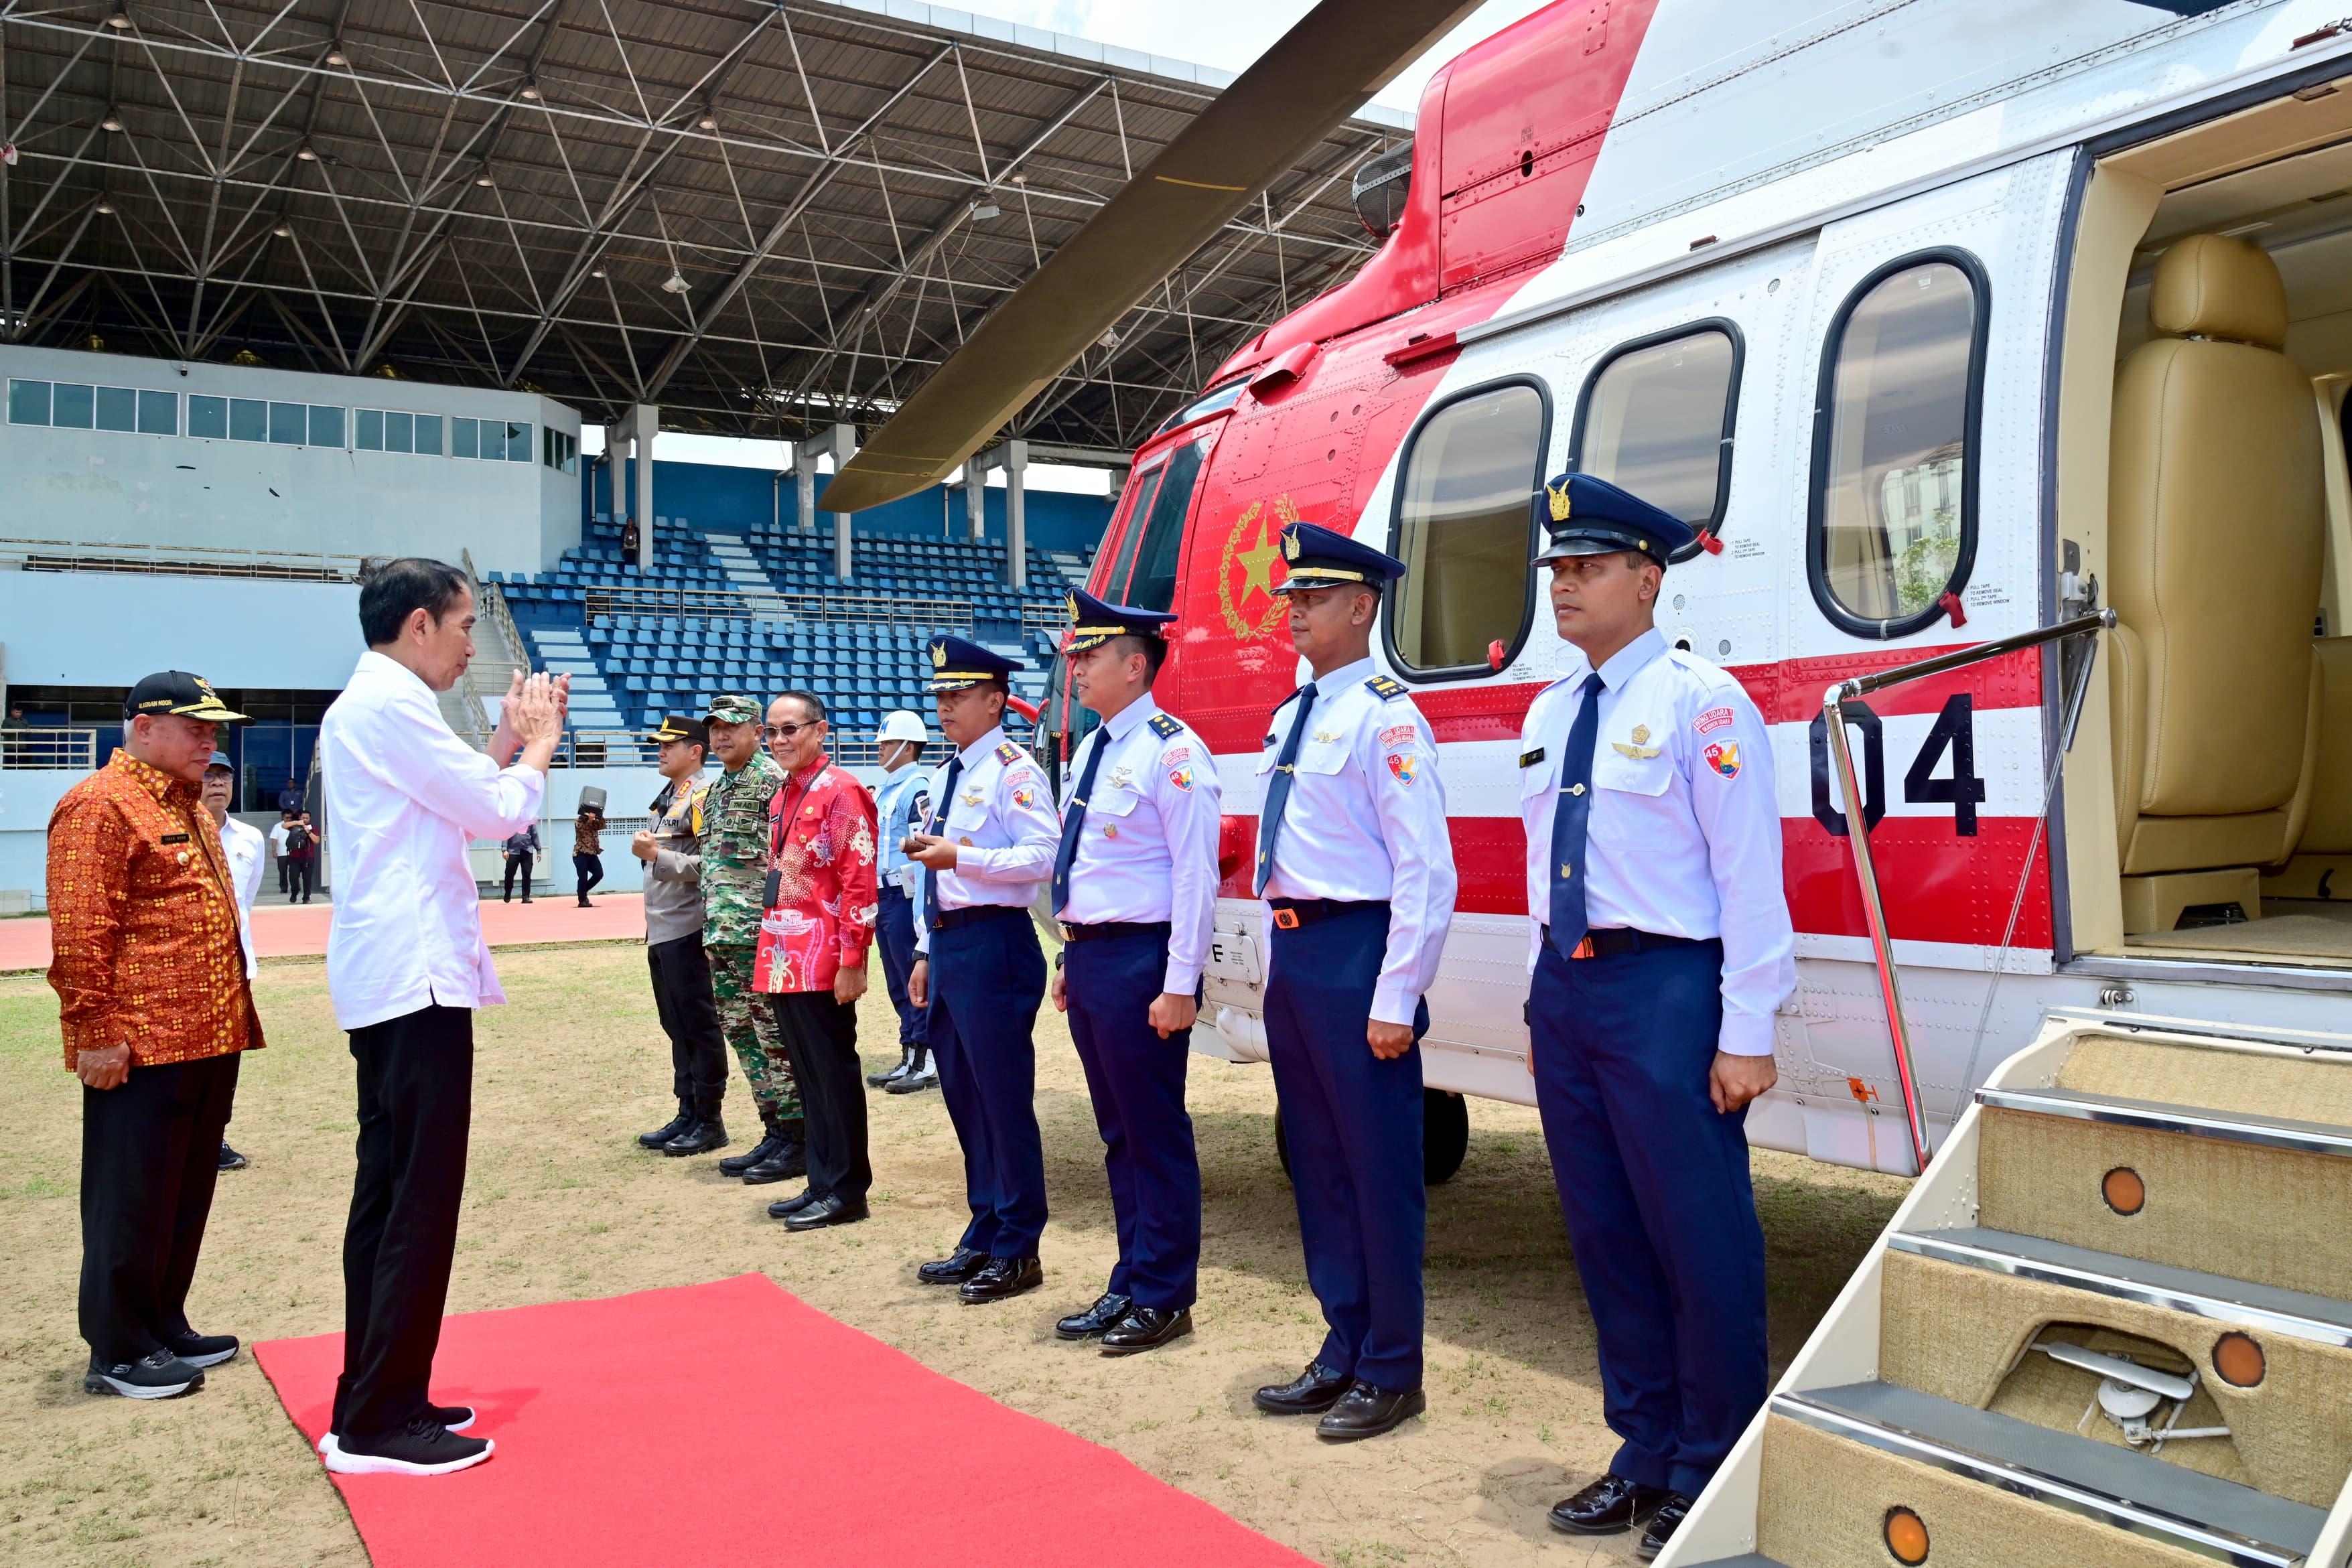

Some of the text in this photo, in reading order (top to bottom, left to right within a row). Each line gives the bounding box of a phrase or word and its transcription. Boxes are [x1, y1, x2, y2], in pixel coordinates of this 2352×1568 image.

[1693, 715, 1709, 727] WING
[1708, 709, 1728, 719] UDARA
[1380, 730, 1393, 741] WING
[1393, 726, 1411, 735] UDARA
[1706, 747, 1719, 758] 45
[1389, 757, 1399, 765] 45
[1809, 694, 1985, 837] 04
[661, 818, 679, 827] POLRI
